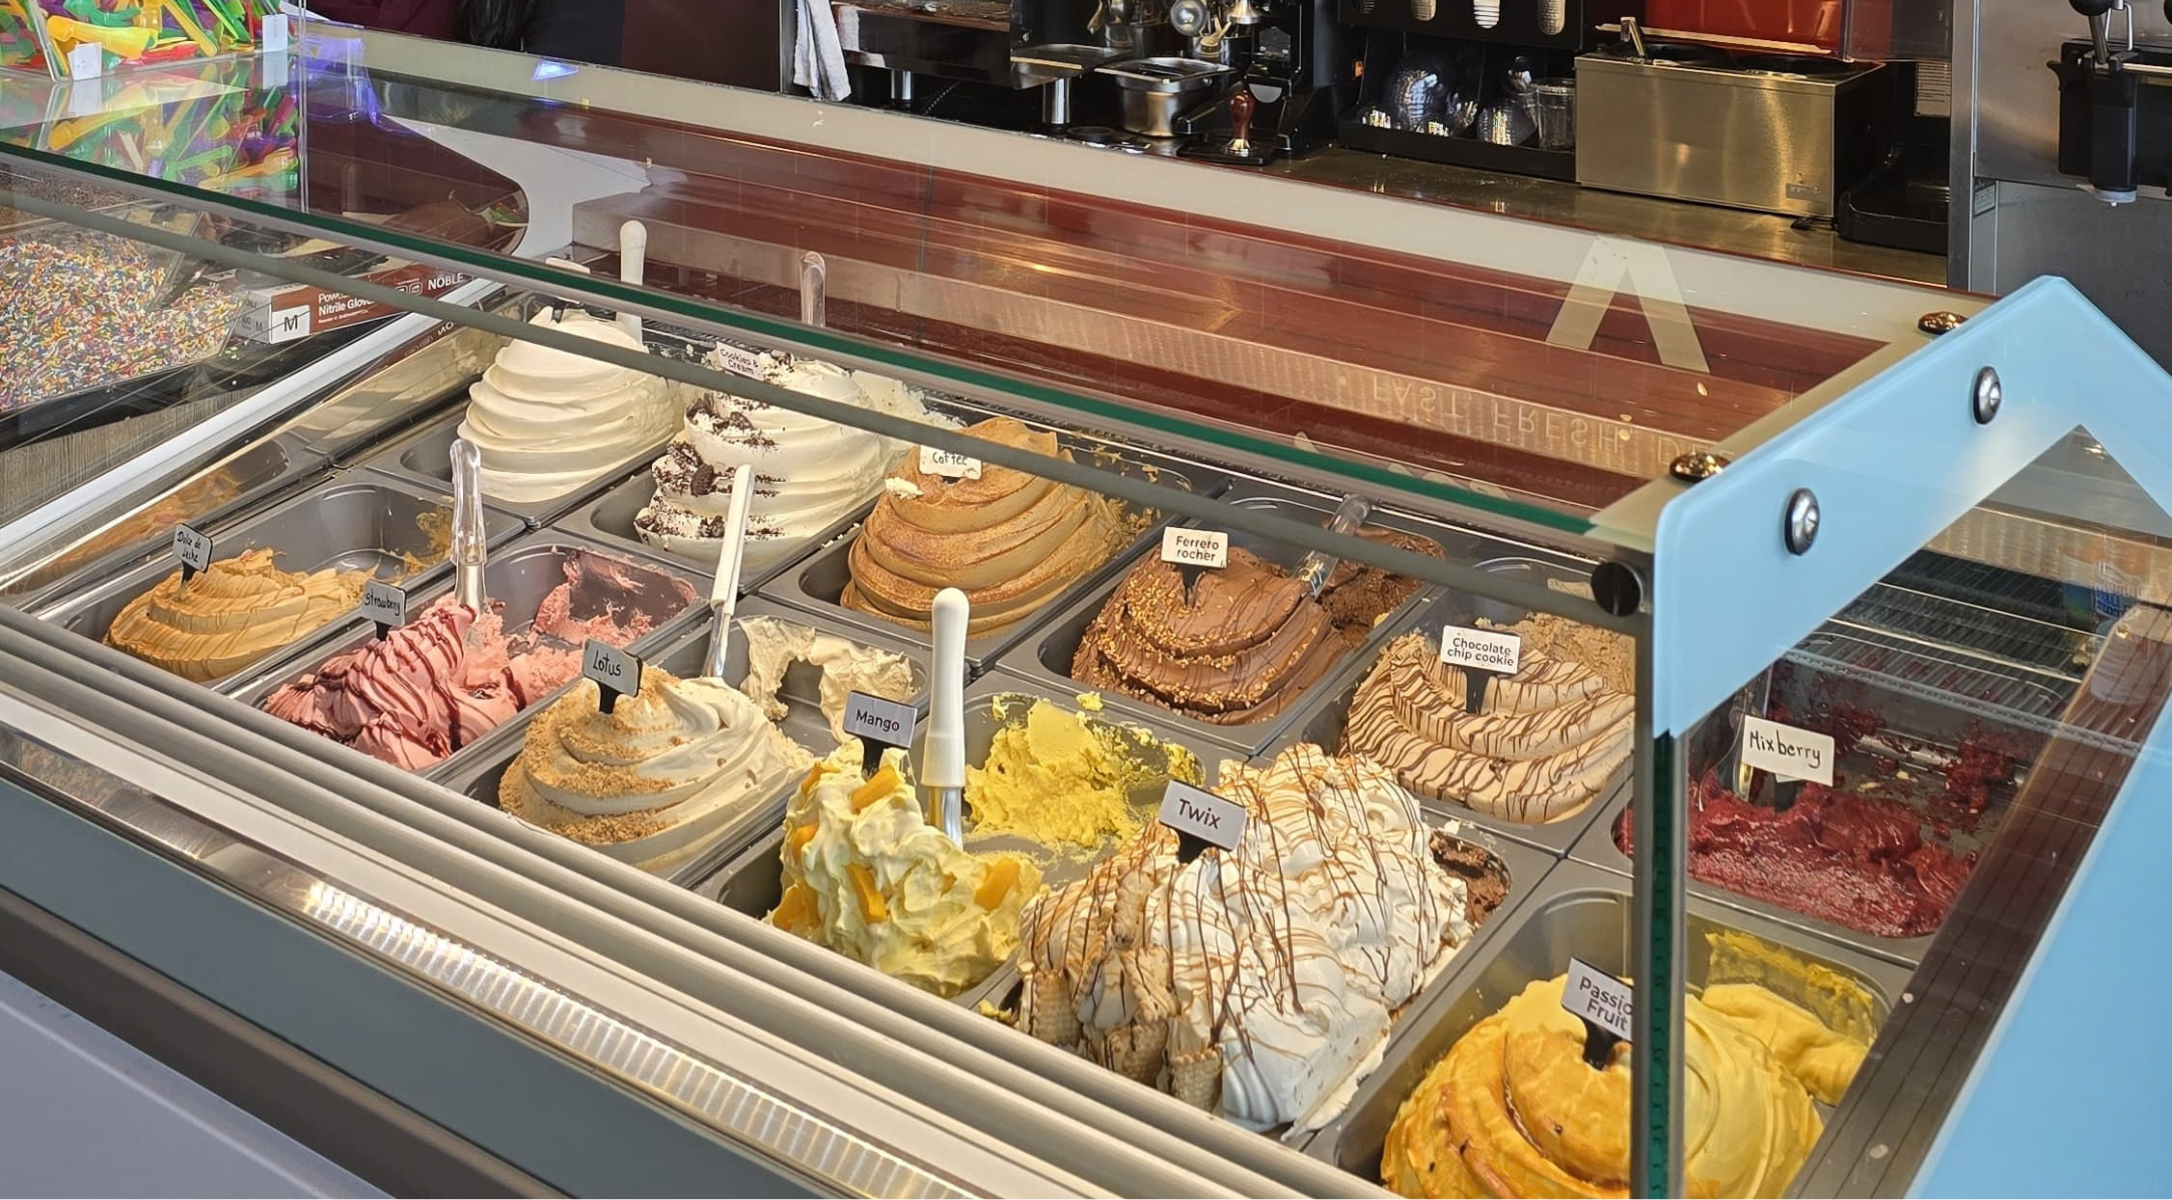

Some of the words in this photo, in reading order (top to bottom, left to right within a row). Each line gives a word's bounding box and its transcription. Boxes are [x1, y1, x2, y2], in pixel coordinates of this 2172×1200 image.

[428, 272, 464, 291] NOBLE
[318, 301, 346, 316] Nitrile
[347, 297, 376, 309] Glov
[284, 315, 298, 332] M
[727, 359, 755, 374] Cream
[1176, 535, 1219, 550] Ferrero
[1177, 549, 1216, 562] rocher
[1452, 637, 1512, 656] Chocolate
[592, 650, 622, 677] Lotus
[1447, 647, 1473, 661] chip
[1475, 652, 1515, 667] cookie
[856, 708, 900, 732] Mango
[1750, 729, 1822, 770] Mixberry
[1179, 798, 1221, 830] Twix
[1579, 976, 1635, 1016] Passio
[1586, 998, 1629, 1032] Fruit
